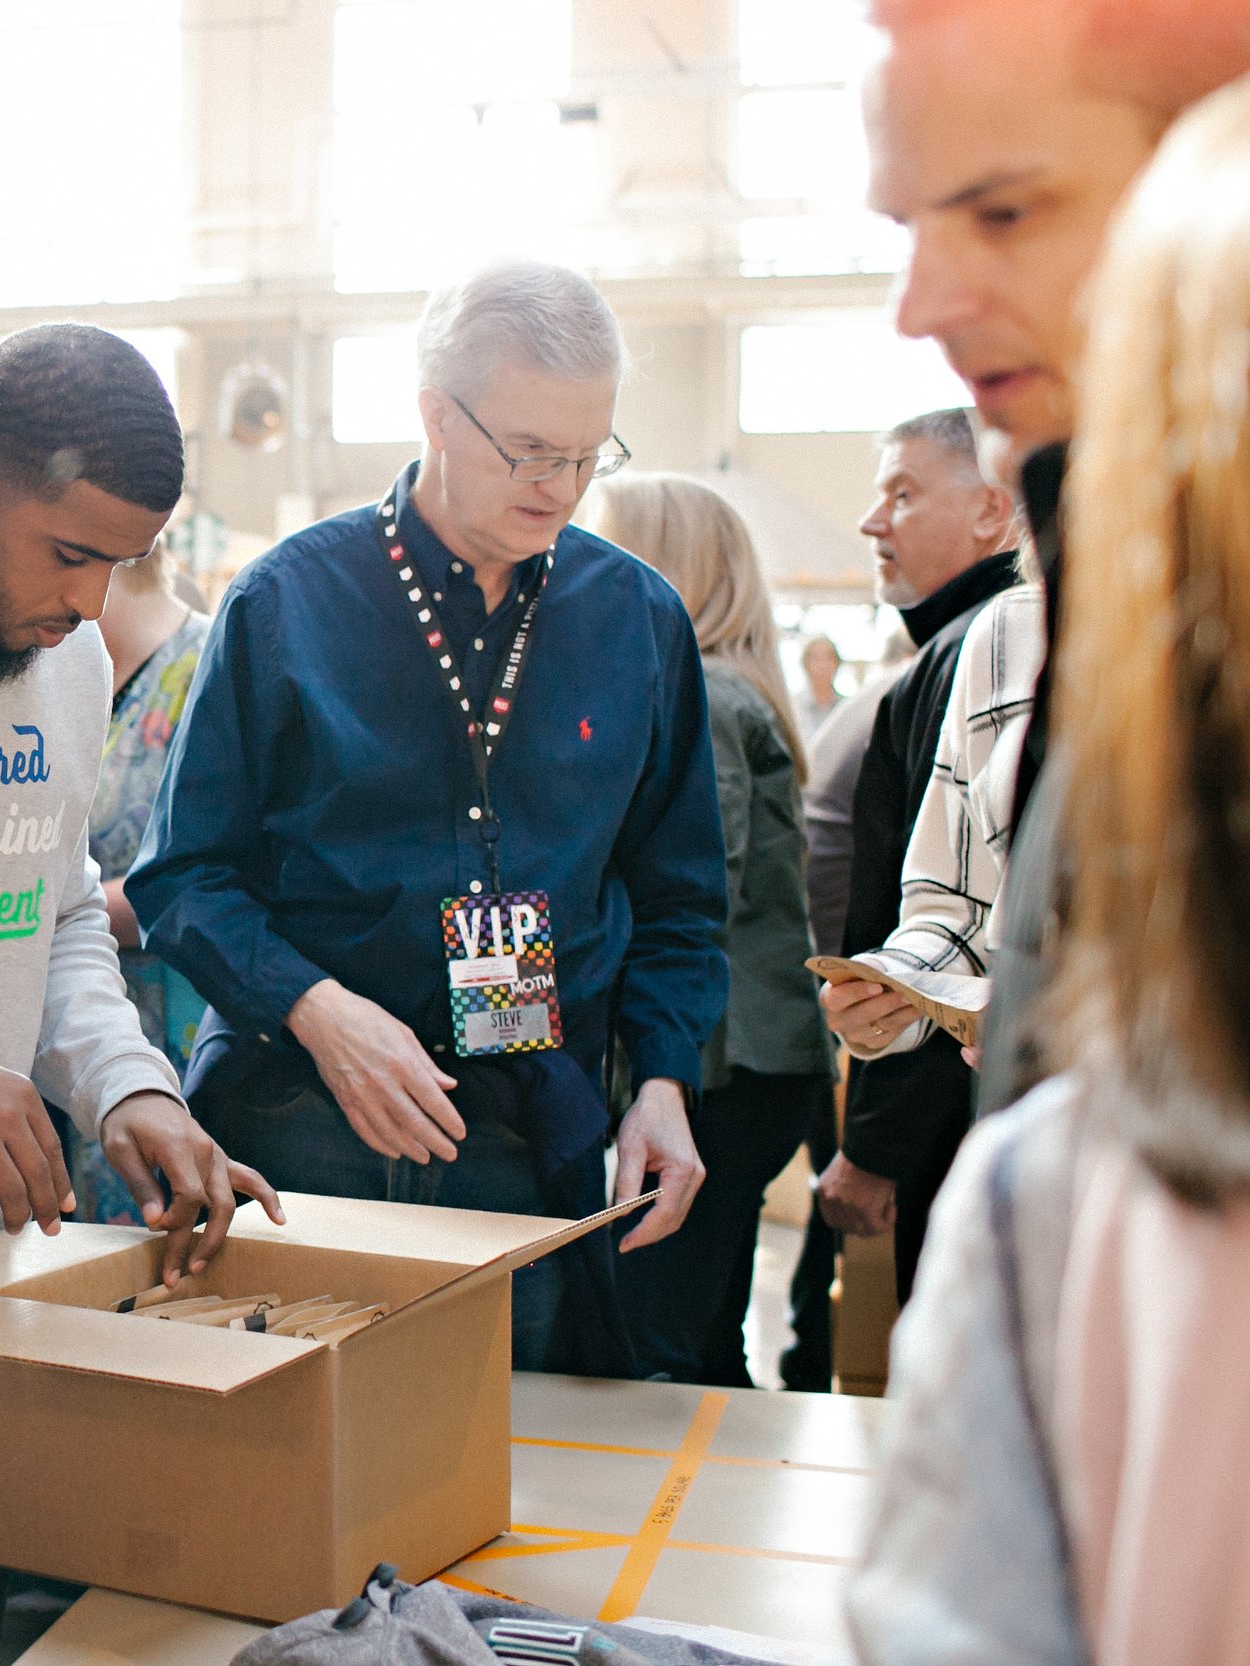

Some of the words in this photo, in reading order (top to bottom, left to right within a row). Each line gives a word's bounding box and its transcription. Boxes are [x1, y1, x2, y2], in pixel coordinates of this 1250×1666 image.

[513, 631, 528, 650] NOT
[509, 652, 522, 664] IS
[501, 665, 518, 689] THIS
[454, 904, 538, 960] VIP
[510, 973, 556, 995] MOTM
[490, 1009, 523, 1029] STEVE
